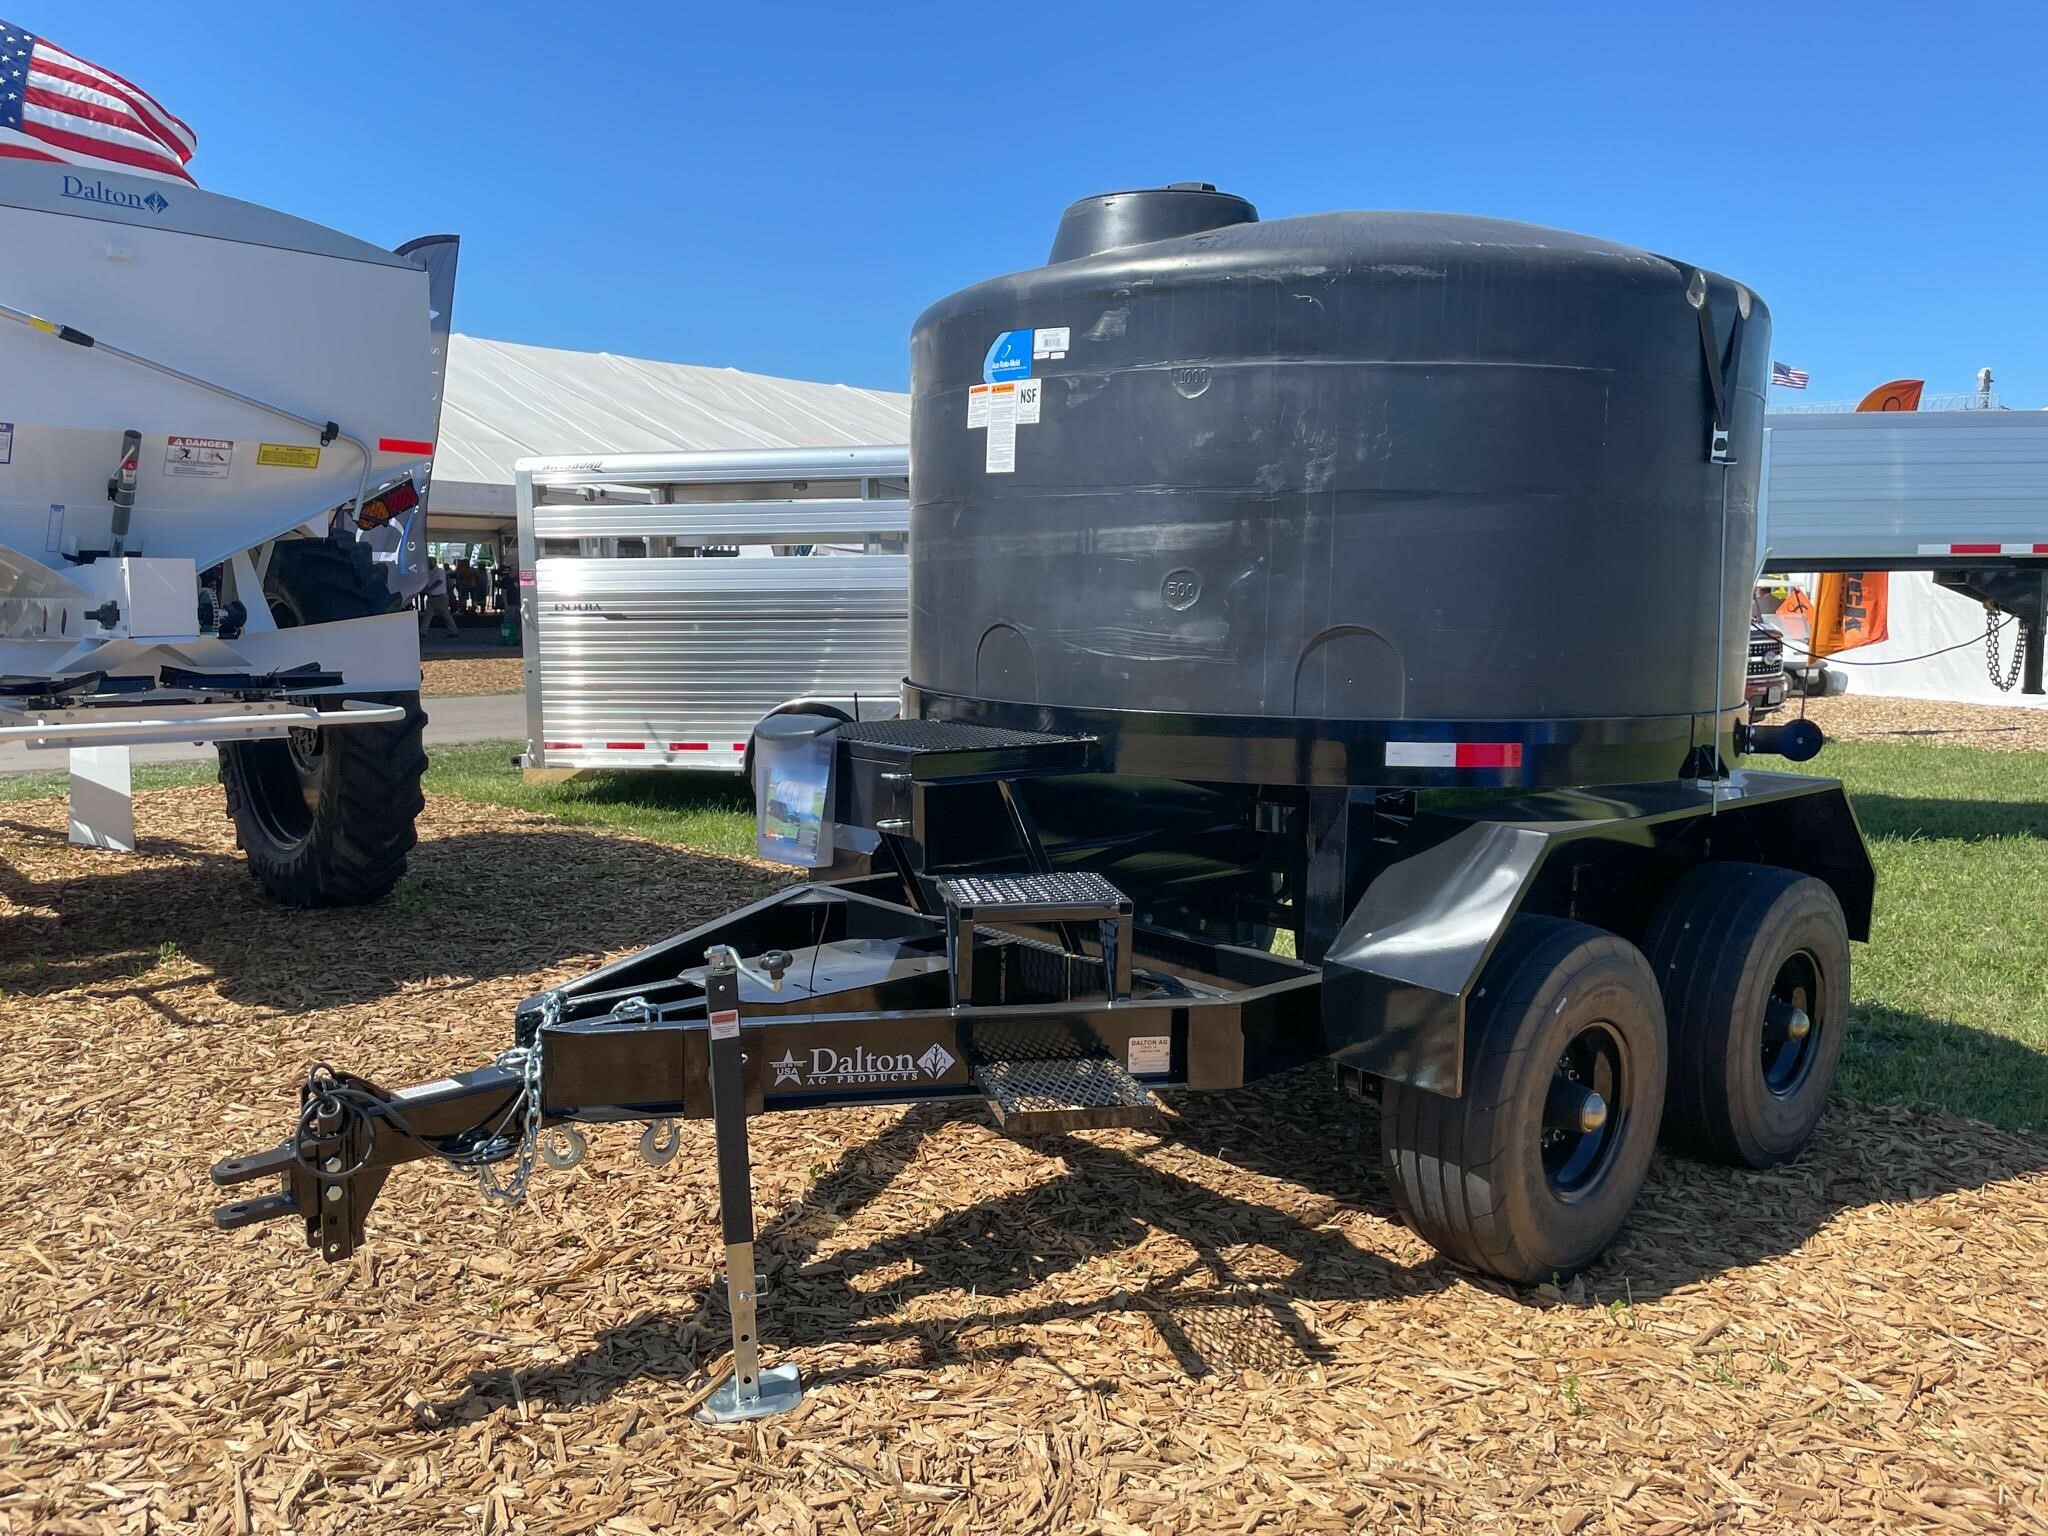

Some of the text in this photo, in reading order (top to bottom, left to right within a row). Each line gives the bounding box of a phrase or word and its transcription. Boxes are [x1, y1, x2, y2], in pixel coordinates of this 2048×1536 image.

[62, 175, 142, 205] Dalton
[1020, 388, 1037, 404] NSF
[185, 438, 229, 449] DANGER
[1167, 581, 1195, 597] 500
[809, 1045, 916, 1075] Dalton
[776, 1067, 798, 1075] USA
[807, 1073, 918, 1085] AG PRODUCTS
